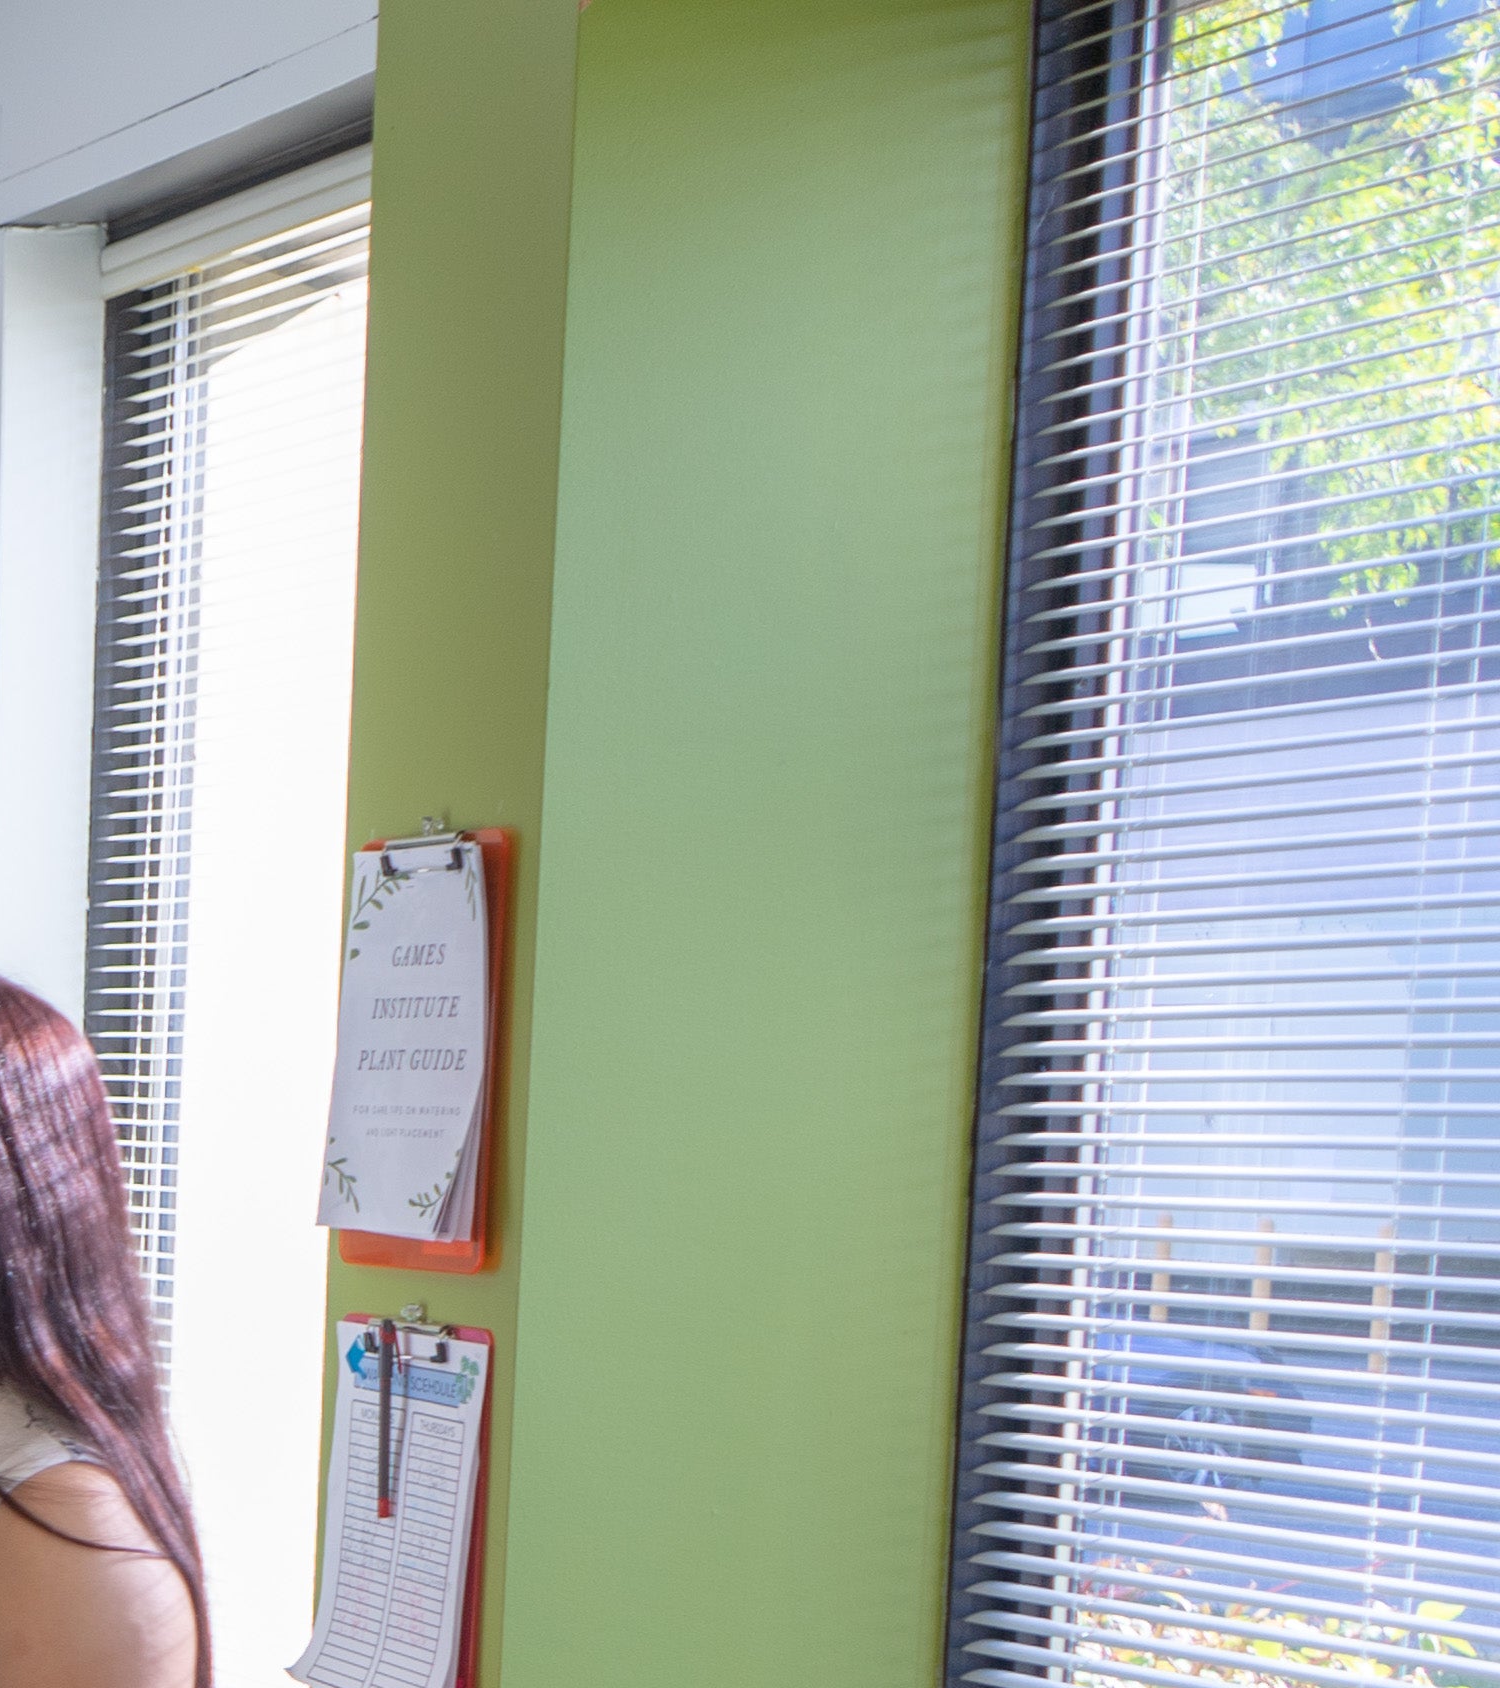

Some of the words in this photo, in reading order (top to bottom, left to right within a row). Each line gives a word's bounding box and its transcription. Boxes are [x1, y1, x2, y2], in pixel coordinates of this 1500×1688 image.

[391, 943, 447, 967] GAMES
[371, 995, 461, 1019] INSTITUTE
[357, 1049, 407, 1071] PLANT
[409, 1049, 468, 1071] GUIDE
